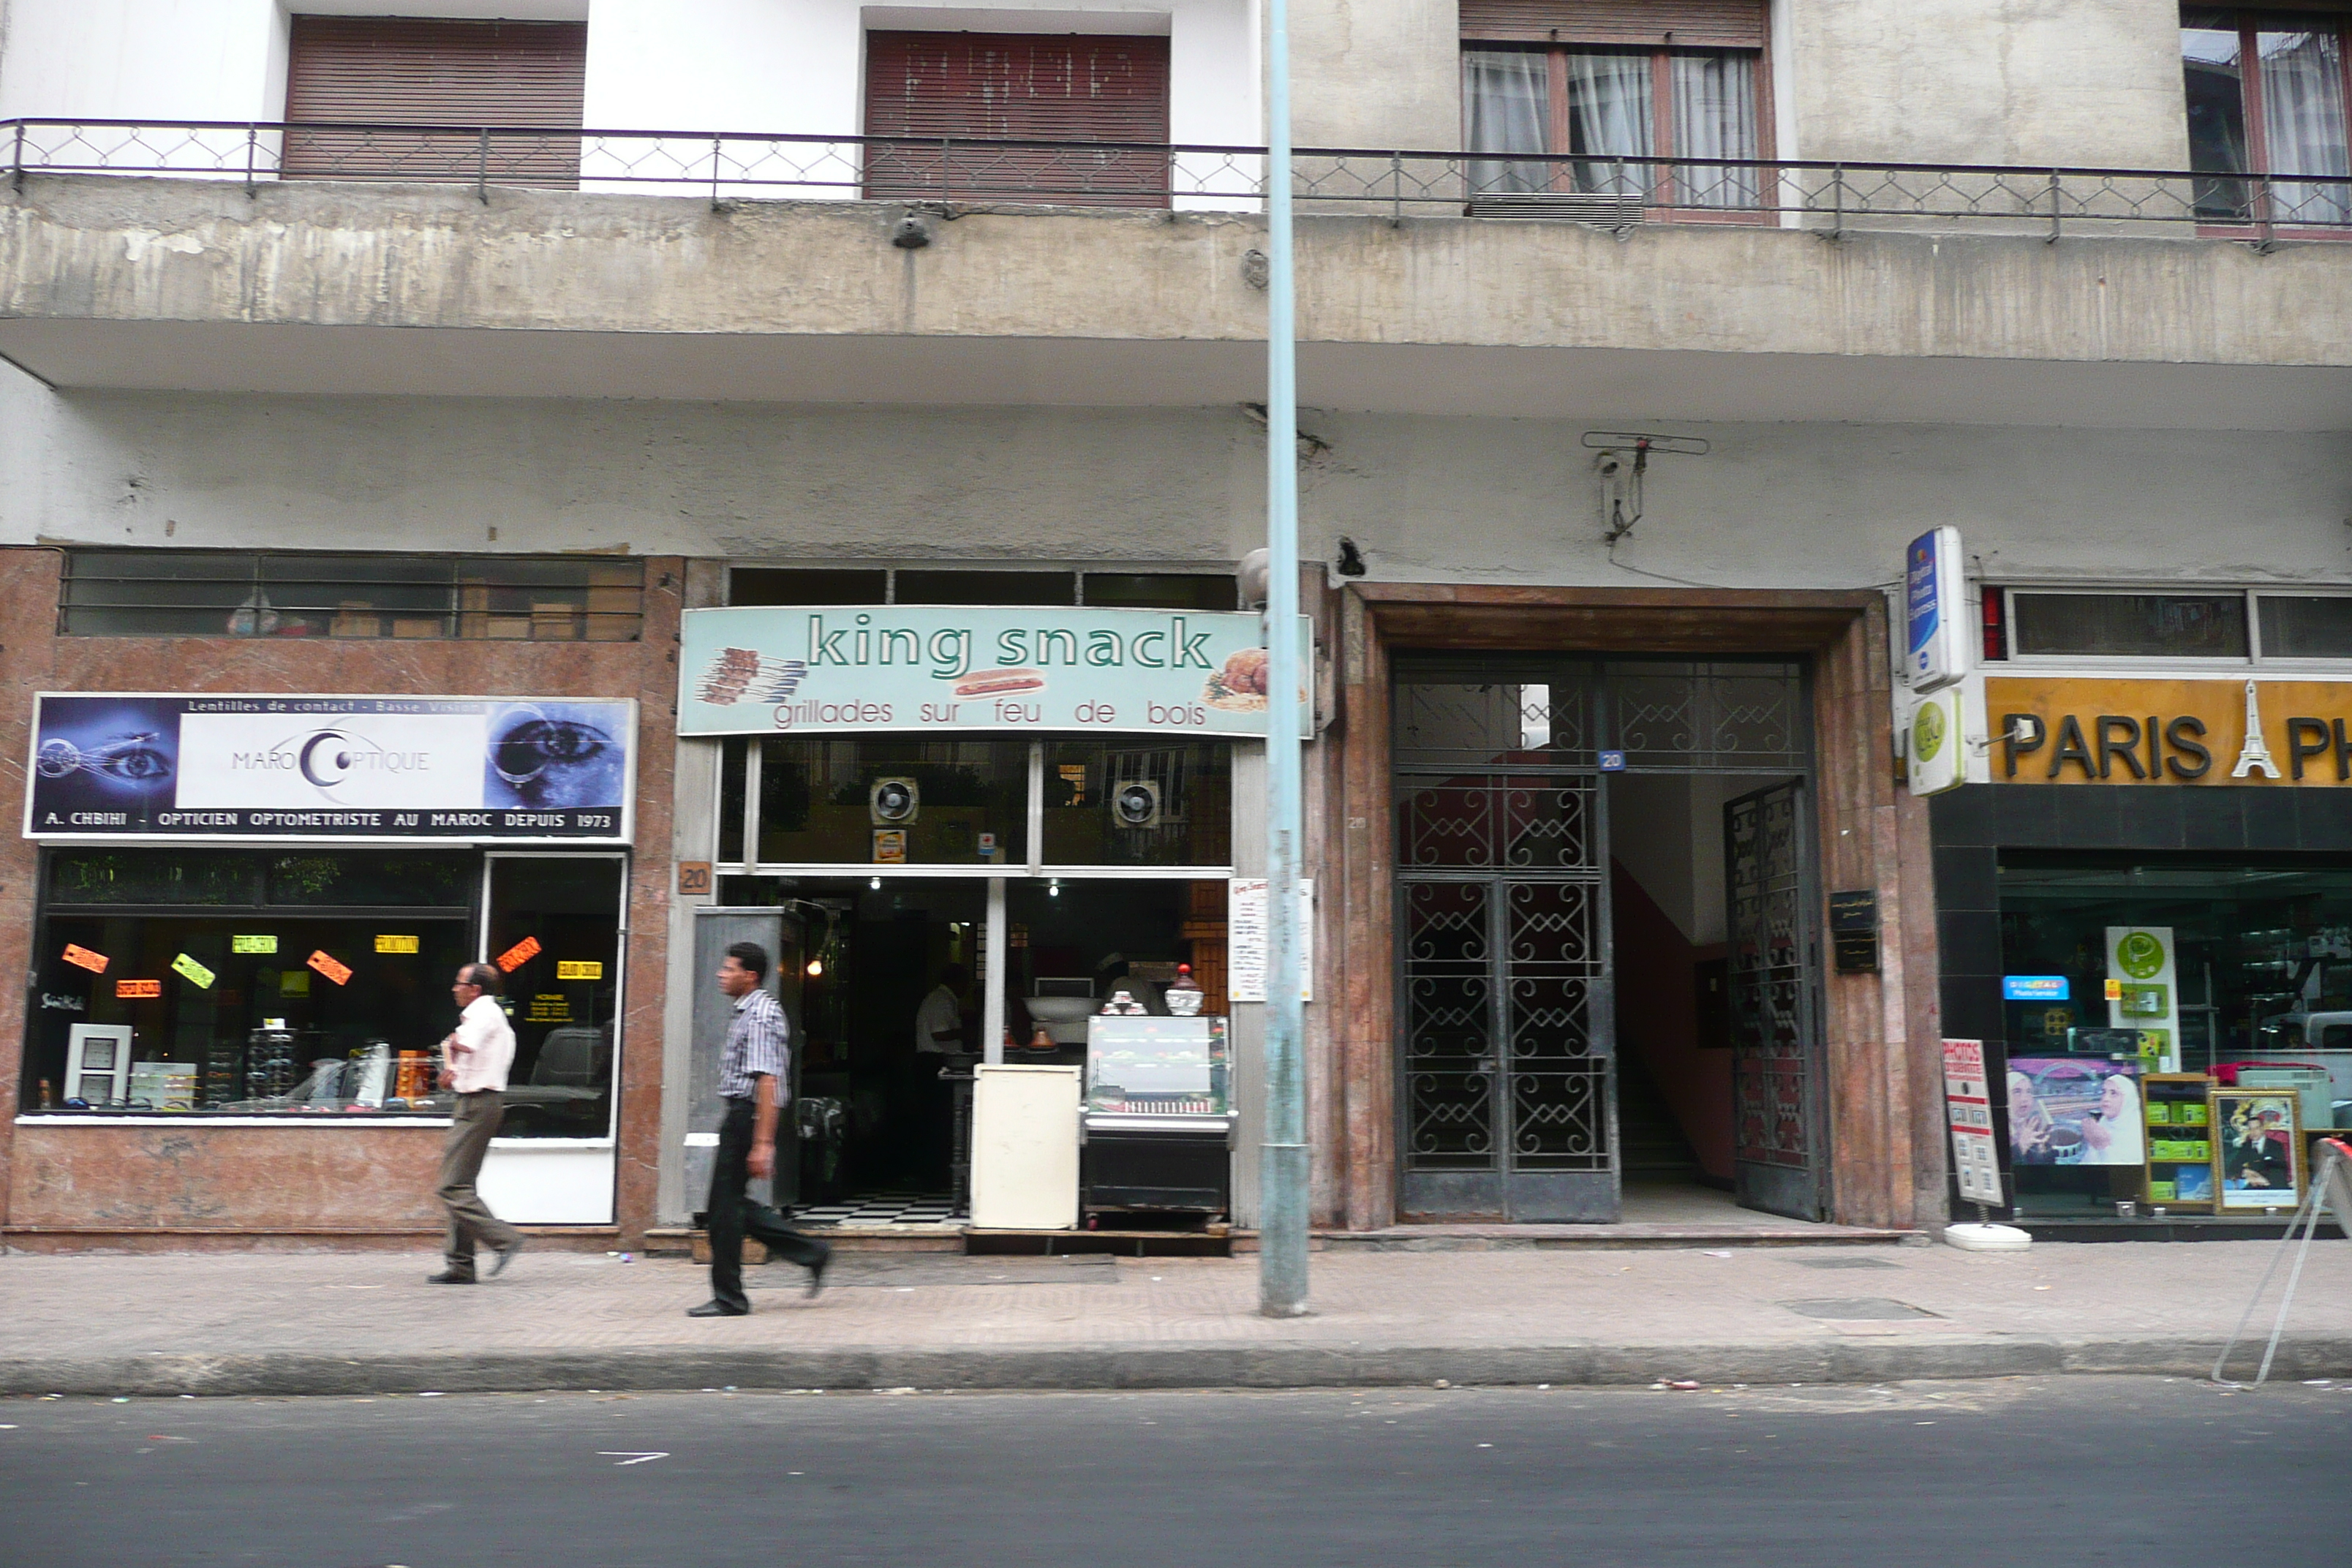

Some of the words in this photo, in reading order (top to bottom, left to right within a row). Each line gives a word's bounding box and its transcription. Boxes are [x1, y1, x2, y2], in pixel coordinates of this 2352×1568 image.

[807, 613, 973, 680] king
[996, 616, 1213, 669] snack
[188, 700, 260, 712] Lentilles
[267, 701, 287, 712] de
[293, 701, 355, 712] contact
[375, 701, 421, 713] Basse
[429, 701, 479, 713] Vision
[773, 698, 893, 729] grillades
[919, 703, 960, 723] sur
[994, 698, 1041, 723] feu
[1074, 699, 1115, 723] de
[1147, 700, 1206, 725] bois
[2003, 712, 2212, 780] PARIS
[1602, 754, 1622, 767] 20
[45, 812, 65, 825] A.
[70, 812, 127, 826] CHBIHI
[158, 812, 238, 826] OPTICIEN
[249, 813, 381, 827] OPTOMETRISTE
[393, 813, 419, 826] AU
[431, 813, 493, 827] MAROC
[505, 813, 565, 828] DEPUIS
[577, 814, 611, 828] 1973
[684, 868, 707, 889] 20
